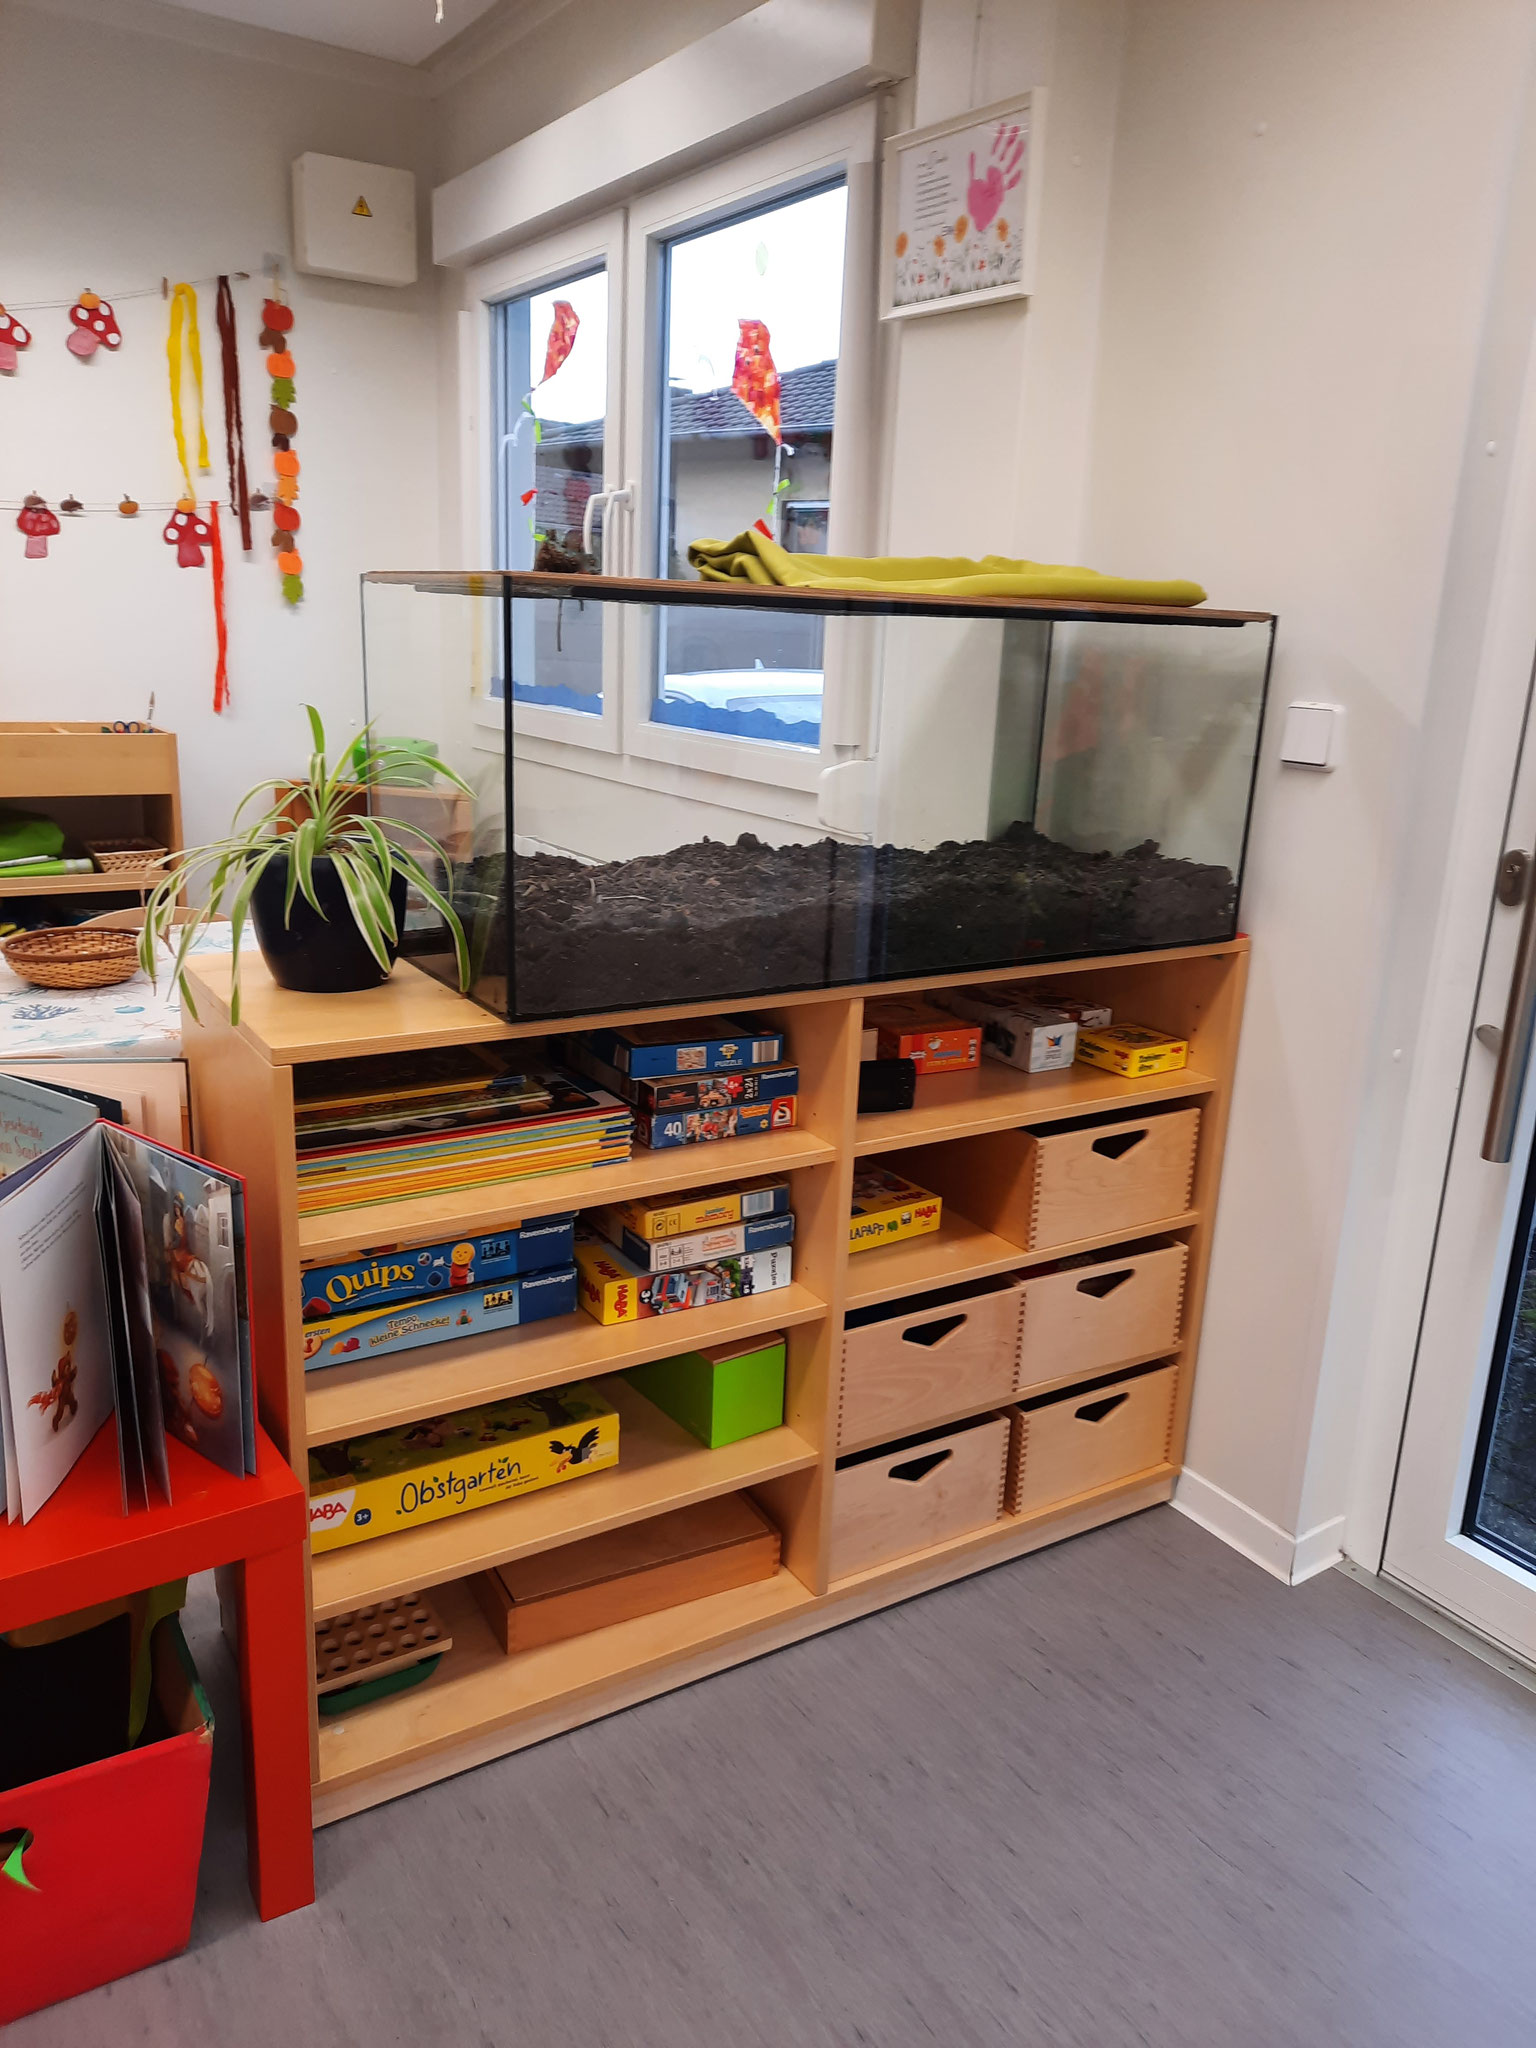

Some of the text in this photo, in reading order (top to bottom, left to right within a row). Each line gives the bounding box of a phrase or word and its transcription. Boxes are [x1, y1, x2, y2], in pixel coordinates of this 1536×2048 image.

[714, 1058, 743, 1068] PUZZLE
[664, 1121, 682, 1137] 40
[519, 1223, 571, 1239] Ravensburger
[748, 1220, 790, 1234] Ravensburger
[325, 1261, 416, 1303] Quips
[522, 1272, 574, 1289] Ravensburger
[614, 1284, 628, 1318] HABA
[641, 1289, 651, 1304] 3+
[304, 1327, 331, 1338] ersten
[370, 1316, 450, 1345] kleine Schnecke!
[400, 1459, 521, 1514] Obstgarten
[356, 1511, 369, 1524] 3+
